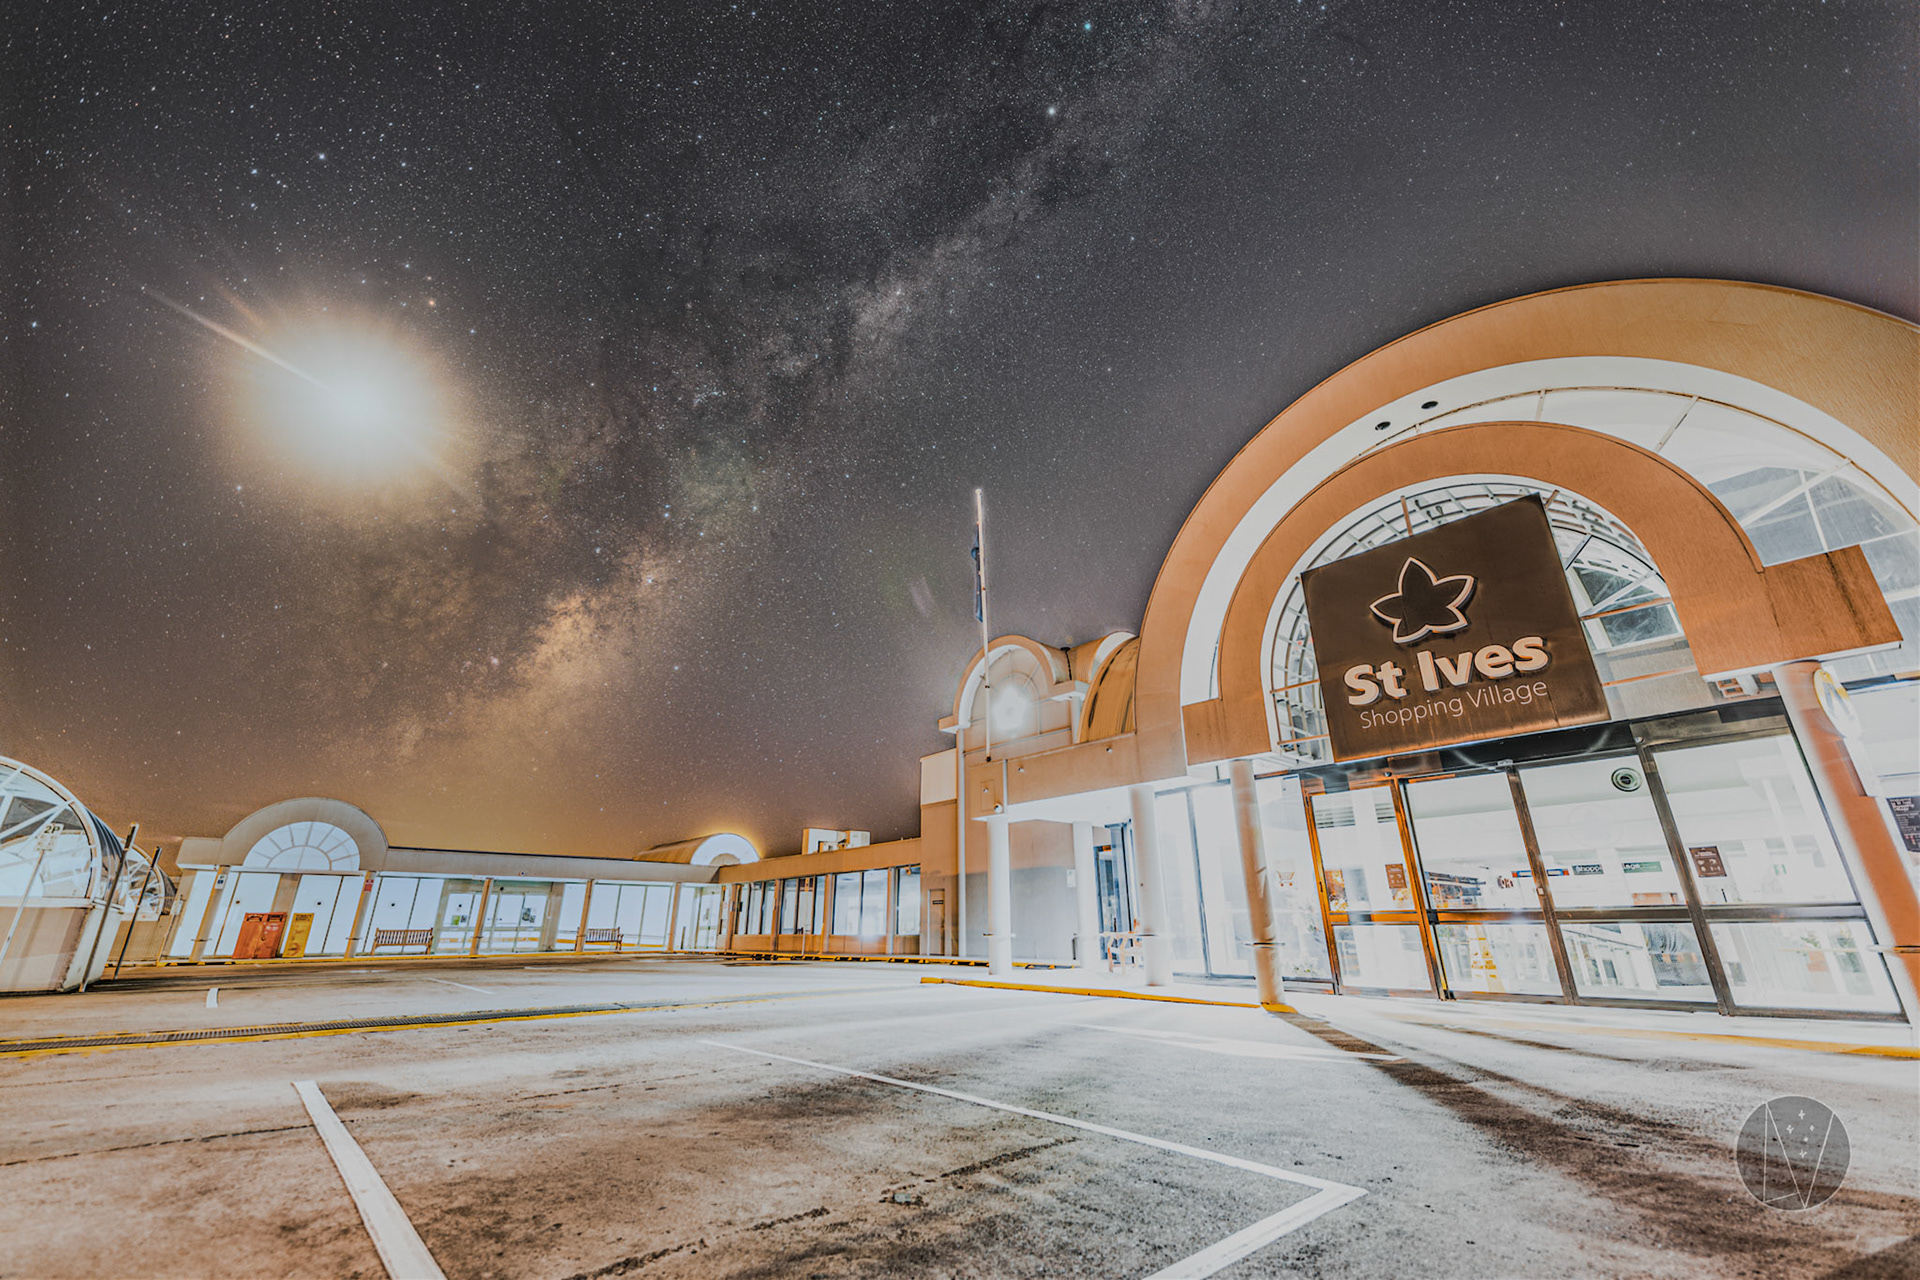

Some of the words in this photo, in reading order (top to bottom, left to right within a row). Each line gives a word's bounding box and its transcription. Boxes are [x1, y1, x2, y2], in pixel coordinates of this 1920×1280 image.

[1344, 660, 1408, 706] St
[1416, 636, 1551, 692] Ives
[1360, 696, 1464, 729] Shopping
[1466, 680, 1548, 709] Village
[44, 825, 61, 834] 2P
